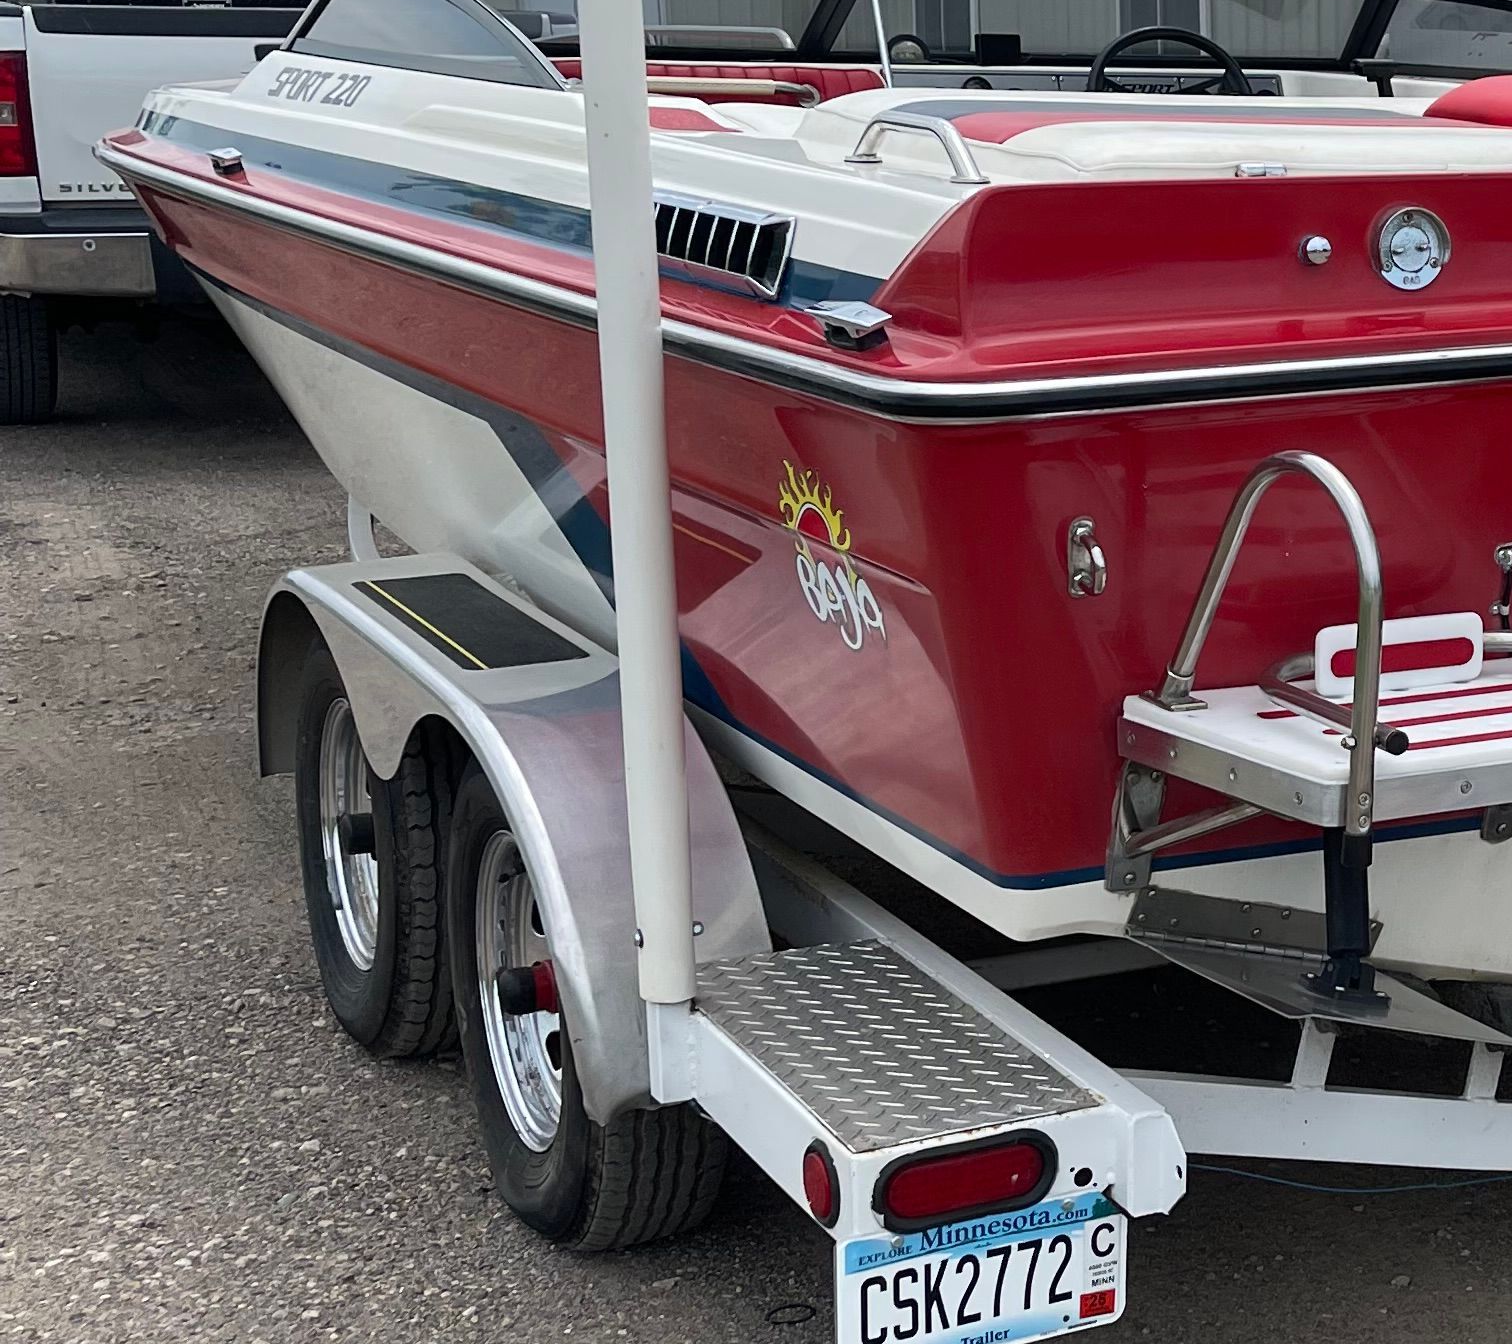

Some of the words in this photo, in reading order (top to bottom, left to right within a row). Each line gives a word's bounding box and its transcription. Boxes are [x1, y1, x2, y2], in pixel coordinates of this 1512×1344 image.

[267, 66, 335, 102] SPORT
[320, 73, 372, 107] 220
[1091, 1222, 1115, 1258] C
